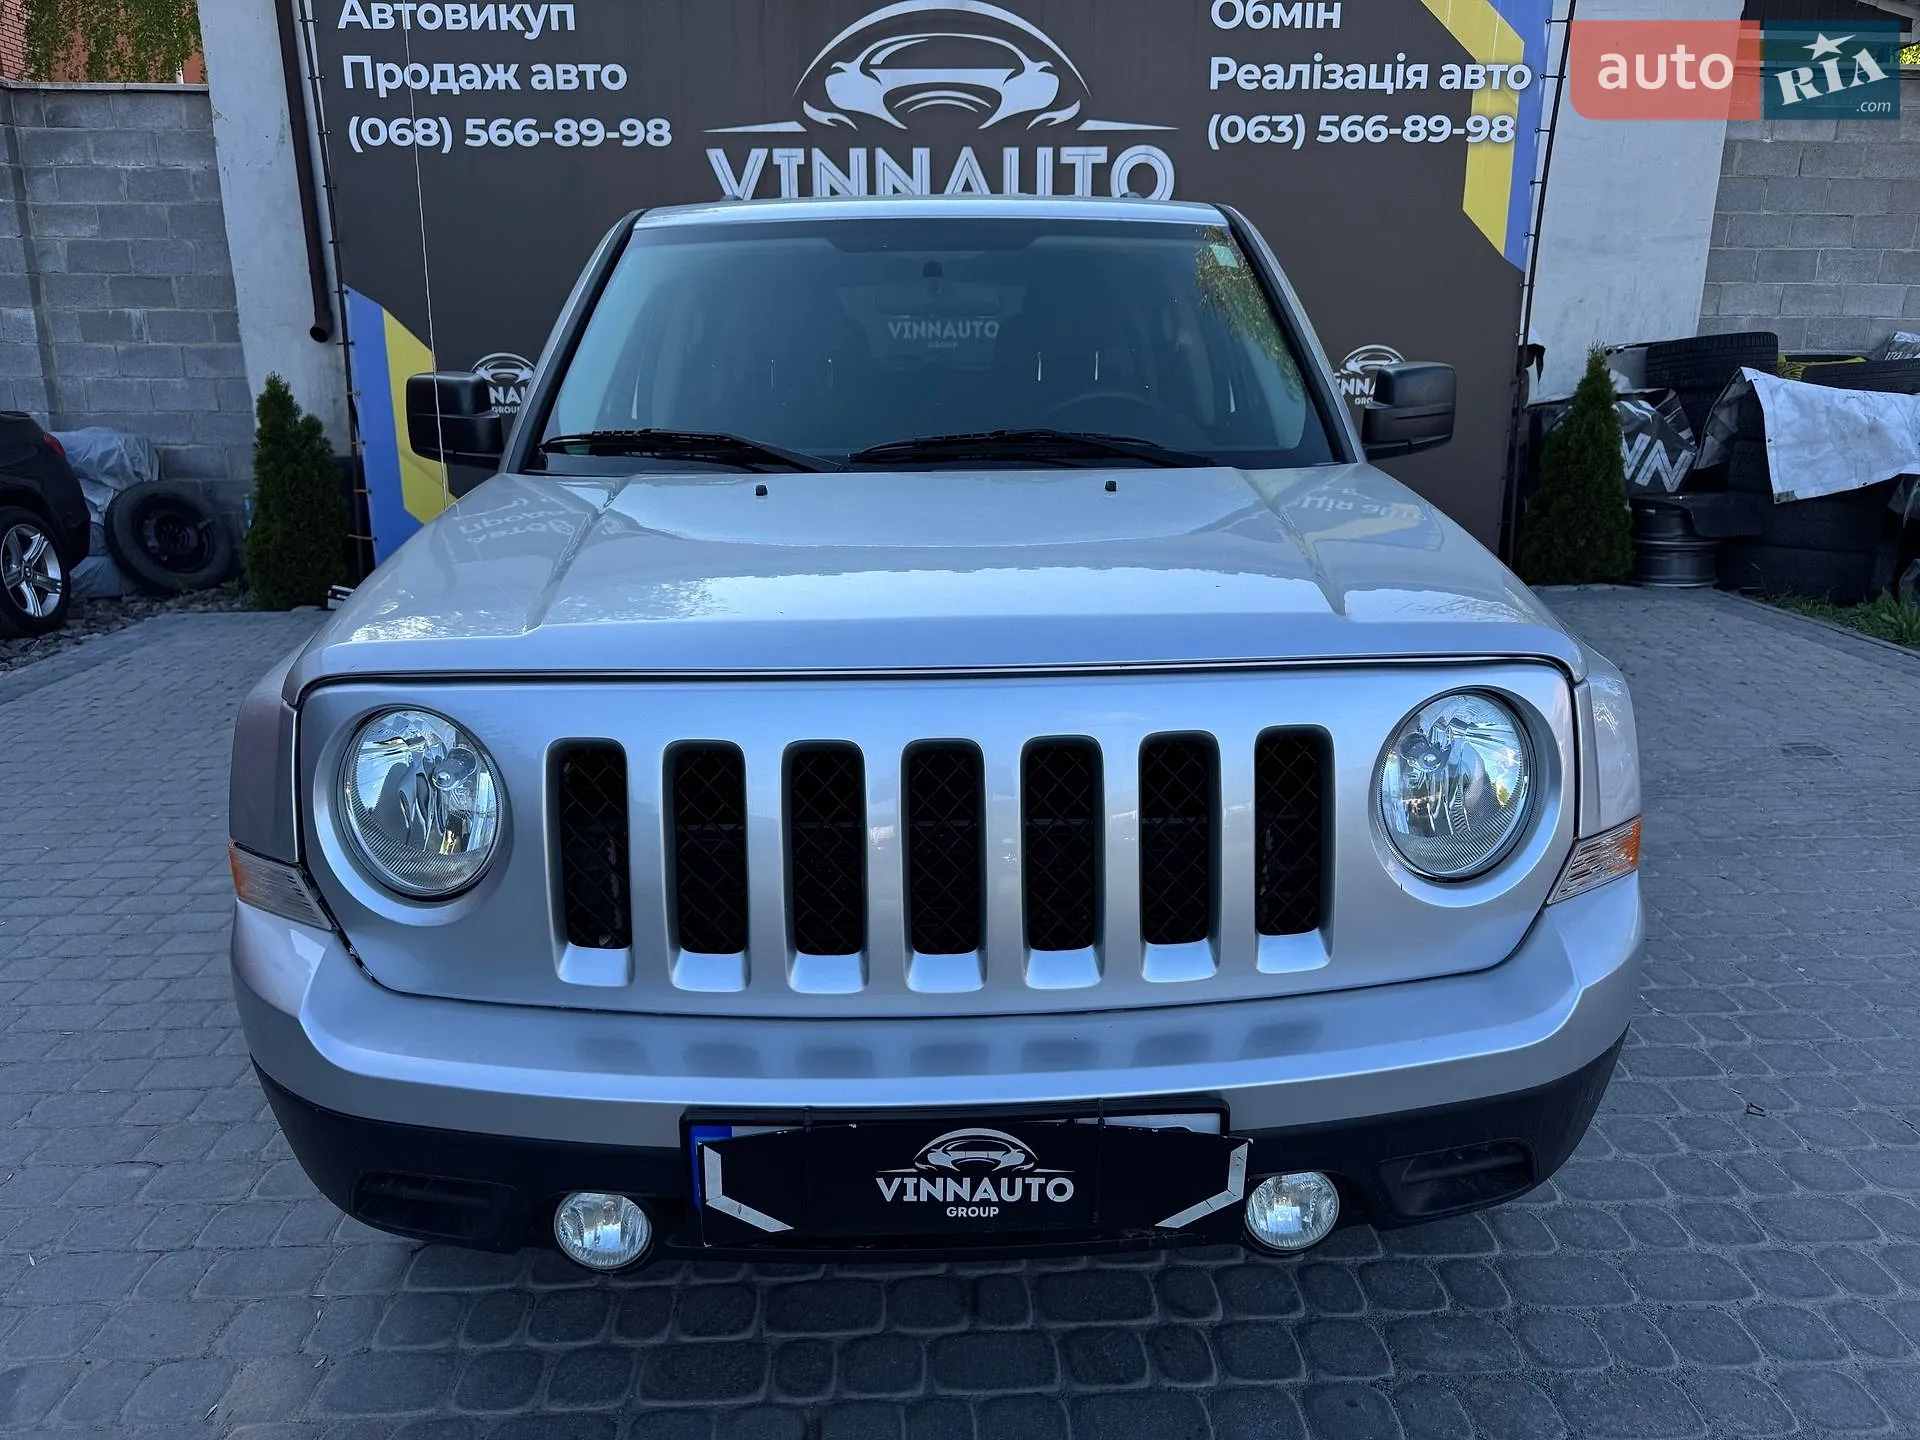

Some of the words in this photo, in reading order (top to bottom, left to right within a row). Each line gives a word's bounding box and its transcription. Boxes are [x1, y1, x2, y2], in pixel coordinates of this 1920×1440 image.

[337, 1, 576, 40] Автовикуп
[1211, 0, 1342, 30] Обмін
[342, 55, 521, 98] Продаж
[530, 63, 628, 91] авто
[1209, 52, 1429, 95] Реалізація
[1439, 63, 1532, 91] авто
[348, 116, 453, 154] (068)
[464, 117, 673, 147] 566-89-98
[1207, 113, 1306, 150] (063)
[1316, 114, 1515, 143] 566-89-98
[706, 144, 1175, 200] VINNAUTO
[887, 320, 1000, 339] VINNAUTO
[875, 1176, 1075, 1203] VINNAUTO
[945, 1205, 1000, 1218] GROUP
